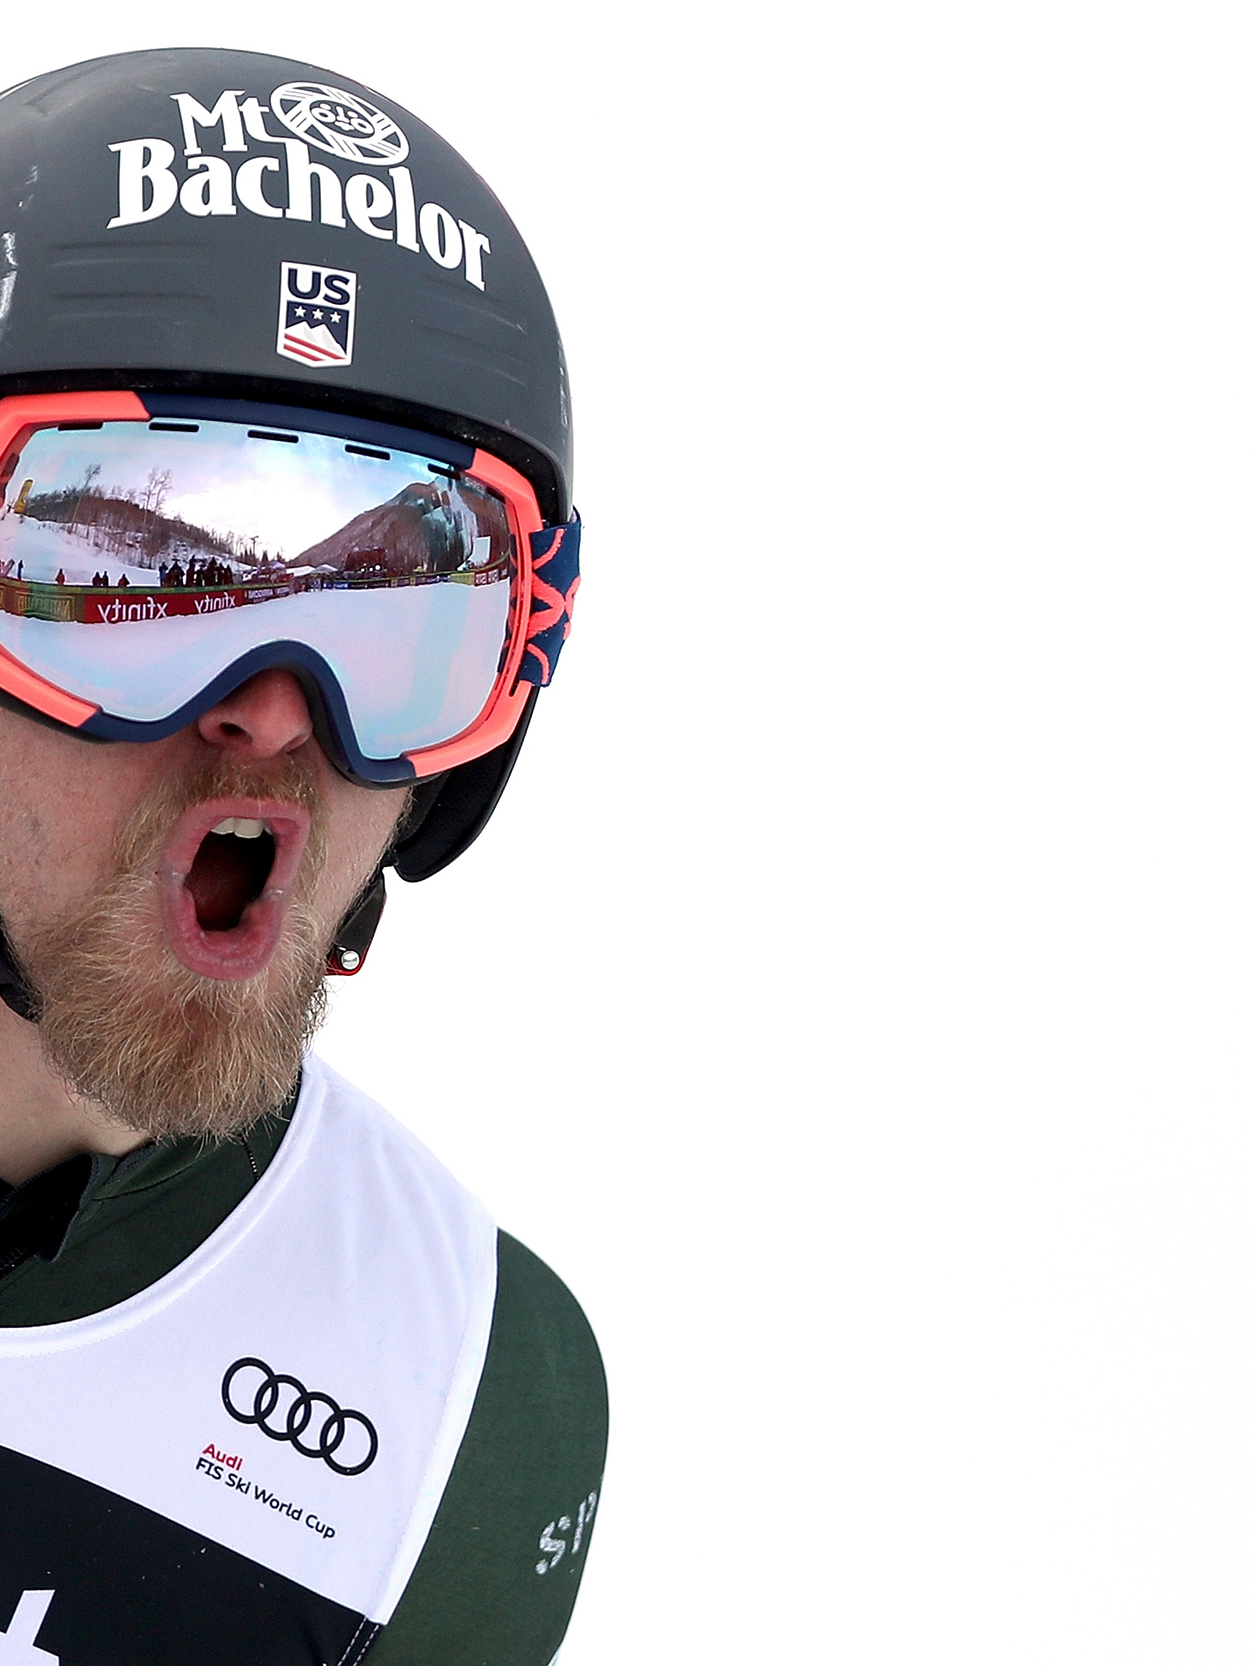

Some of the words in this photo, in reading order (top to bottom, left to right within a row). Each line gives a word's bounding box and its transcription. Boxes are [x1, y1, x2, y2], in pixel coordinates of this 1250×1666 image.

[170, 89, 270, 156] Mt
[107, 138, 491, 292] Bachelor
[287, 267, 351, 306] US
[202, 1443, 243, 1471] Audi
[195, 1457, 224, 1480] FIS
[225, 1473, 251, 1494] Ski
[254, 1485, 303, 1521] World
[305, 1514, 336, 1539] Cup
